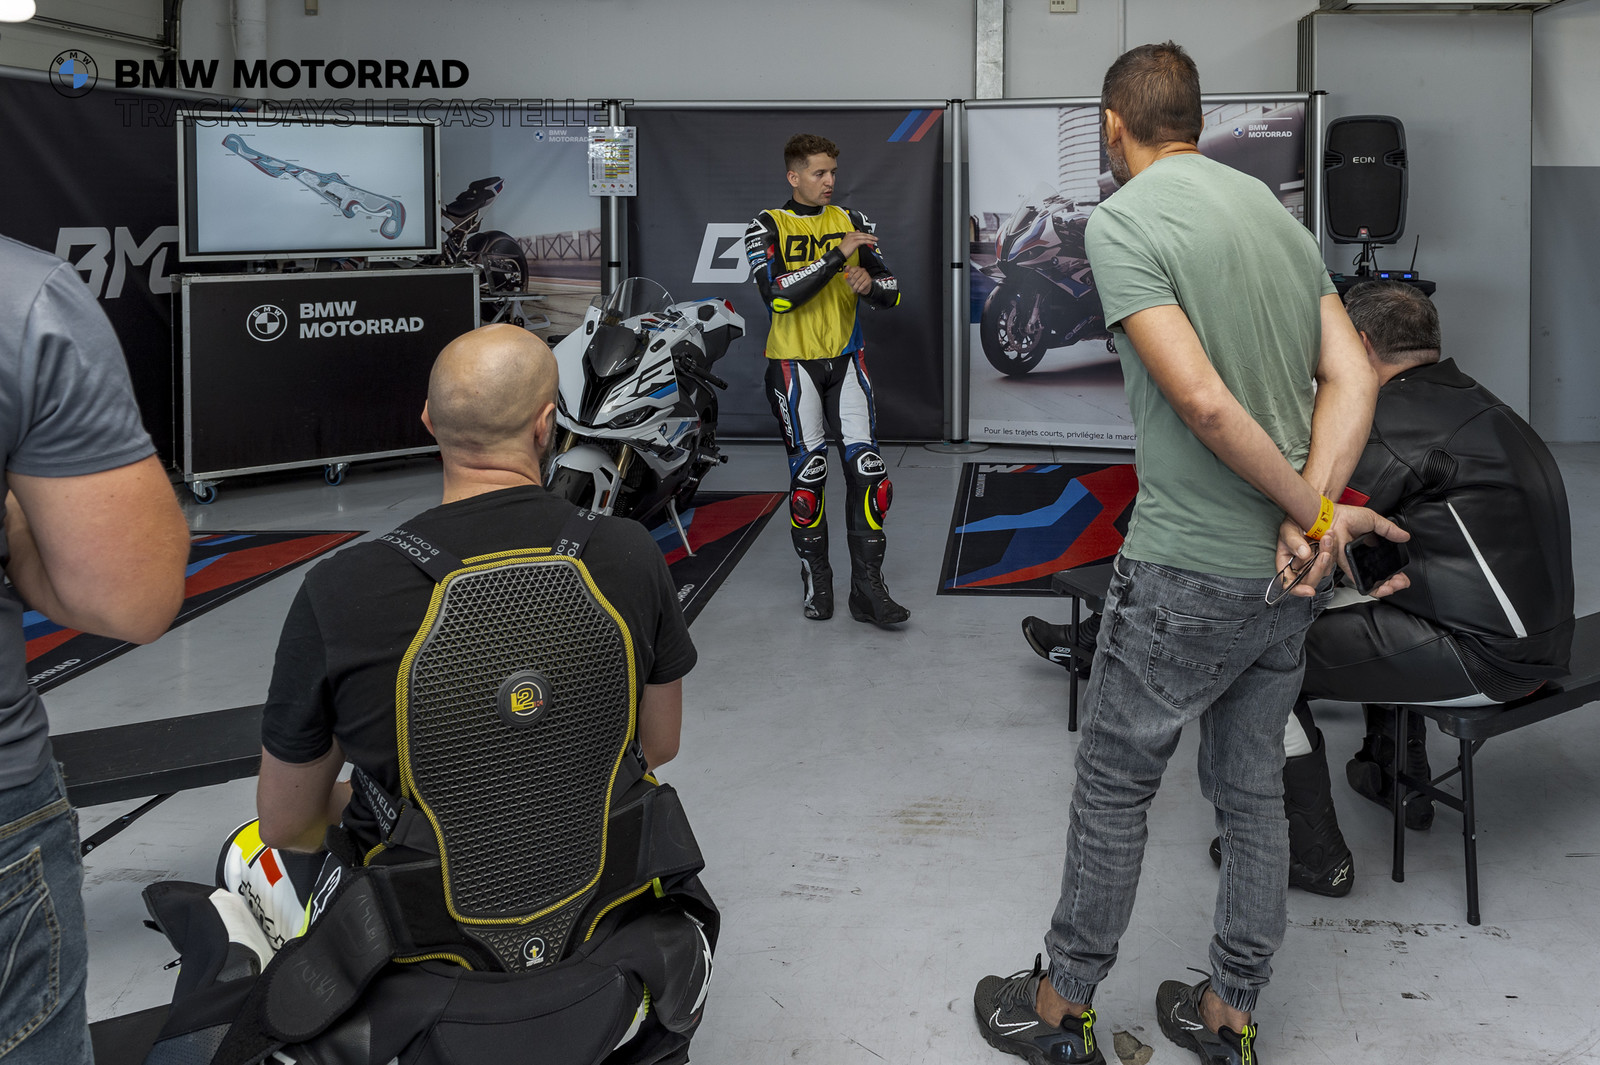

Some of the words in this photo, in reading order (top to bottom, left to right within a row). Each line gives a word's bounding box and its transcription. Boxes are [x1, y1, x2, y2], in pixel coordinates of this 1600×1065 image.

[1352, 156, 1375, 164] EON
[300, 301, 357, 319] BMW
[300, 317, 424, 339] MOTORRAD
[984, 427, 1001, 435] Pour
[1003, 427, 1013, 436] les
[1015, 429, 1038, 438] trajets
[1040, 430, 1065, 439] courts,
[1066, 431, 1104, 441] privilégiez
[406, 534, 440, 556] BODY
